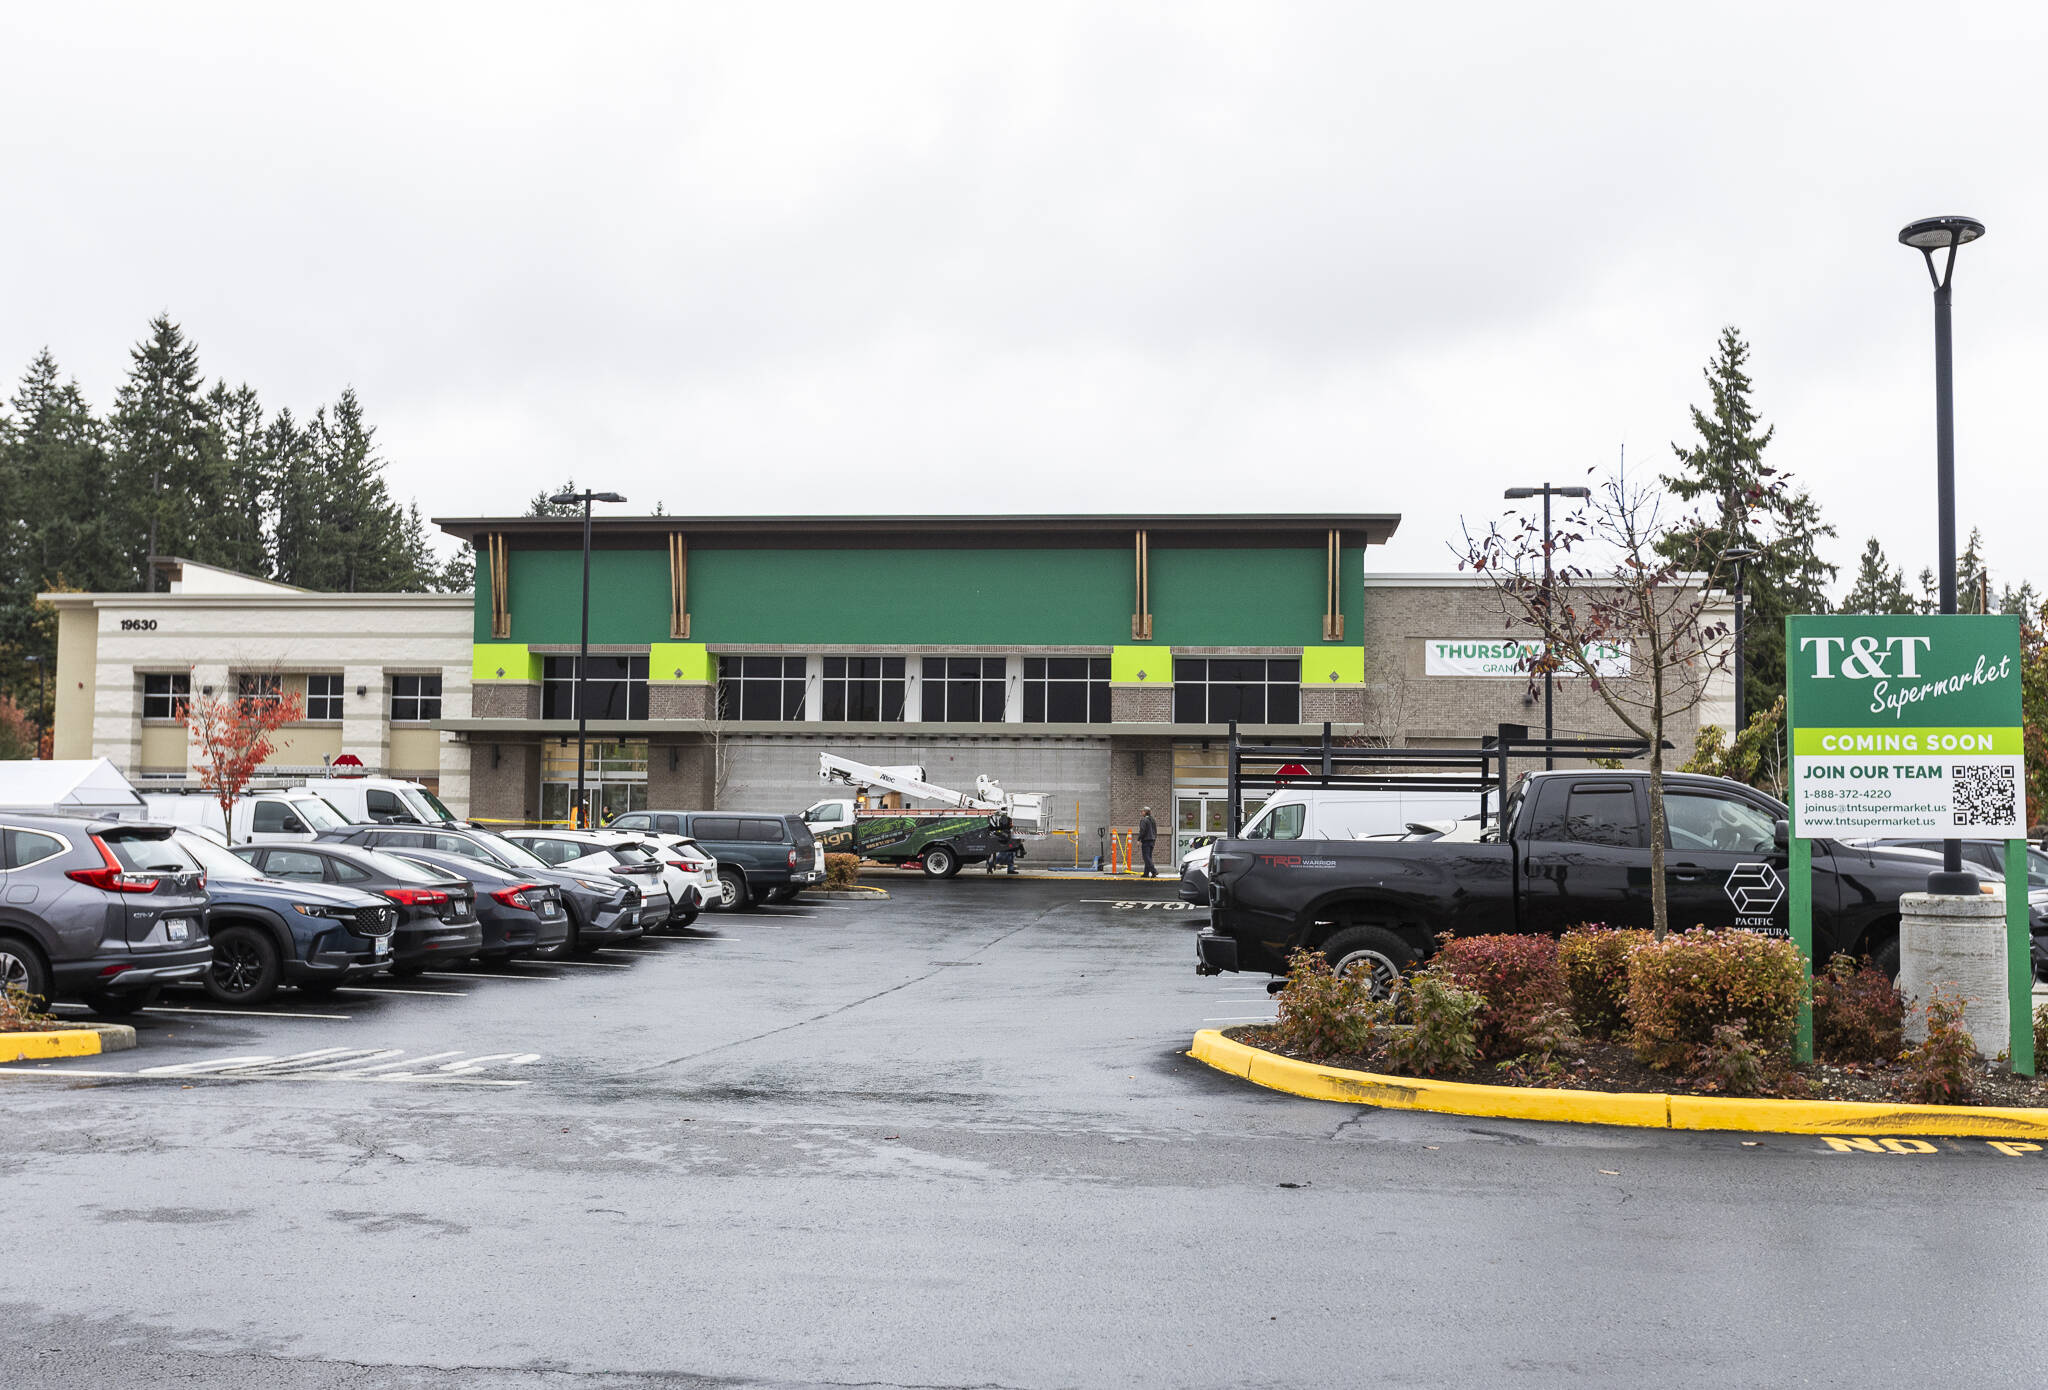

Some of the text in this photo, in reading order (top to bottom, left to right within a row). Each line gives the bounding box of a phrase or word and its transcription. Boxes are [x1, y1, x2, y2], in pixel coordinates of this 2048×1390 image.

[121, 619, 157, 631] 19630
[1436, 644, 1540, 659] THURSDAY
[1800, 636, 1931, 680] T&T
[1870, 654, 2011, 719] Supermarket
[1822, 734, 1993, 751] COMING SOON
[1804, 765, 1943, 779] JOIN OUR TEAM
[1804, 789, 1892, 799] 1-888-372-4220
[1804, 803, 1947, 815] joinus@tntsupermarket.us
[1804, 817, 1936, 828] www.tntsupermarket.us
[1260, 855, 1302, 868] TRD
[1735, 917, 1774, 926] PACIFIC
[1821, 1136, 1939, 1155] NO
